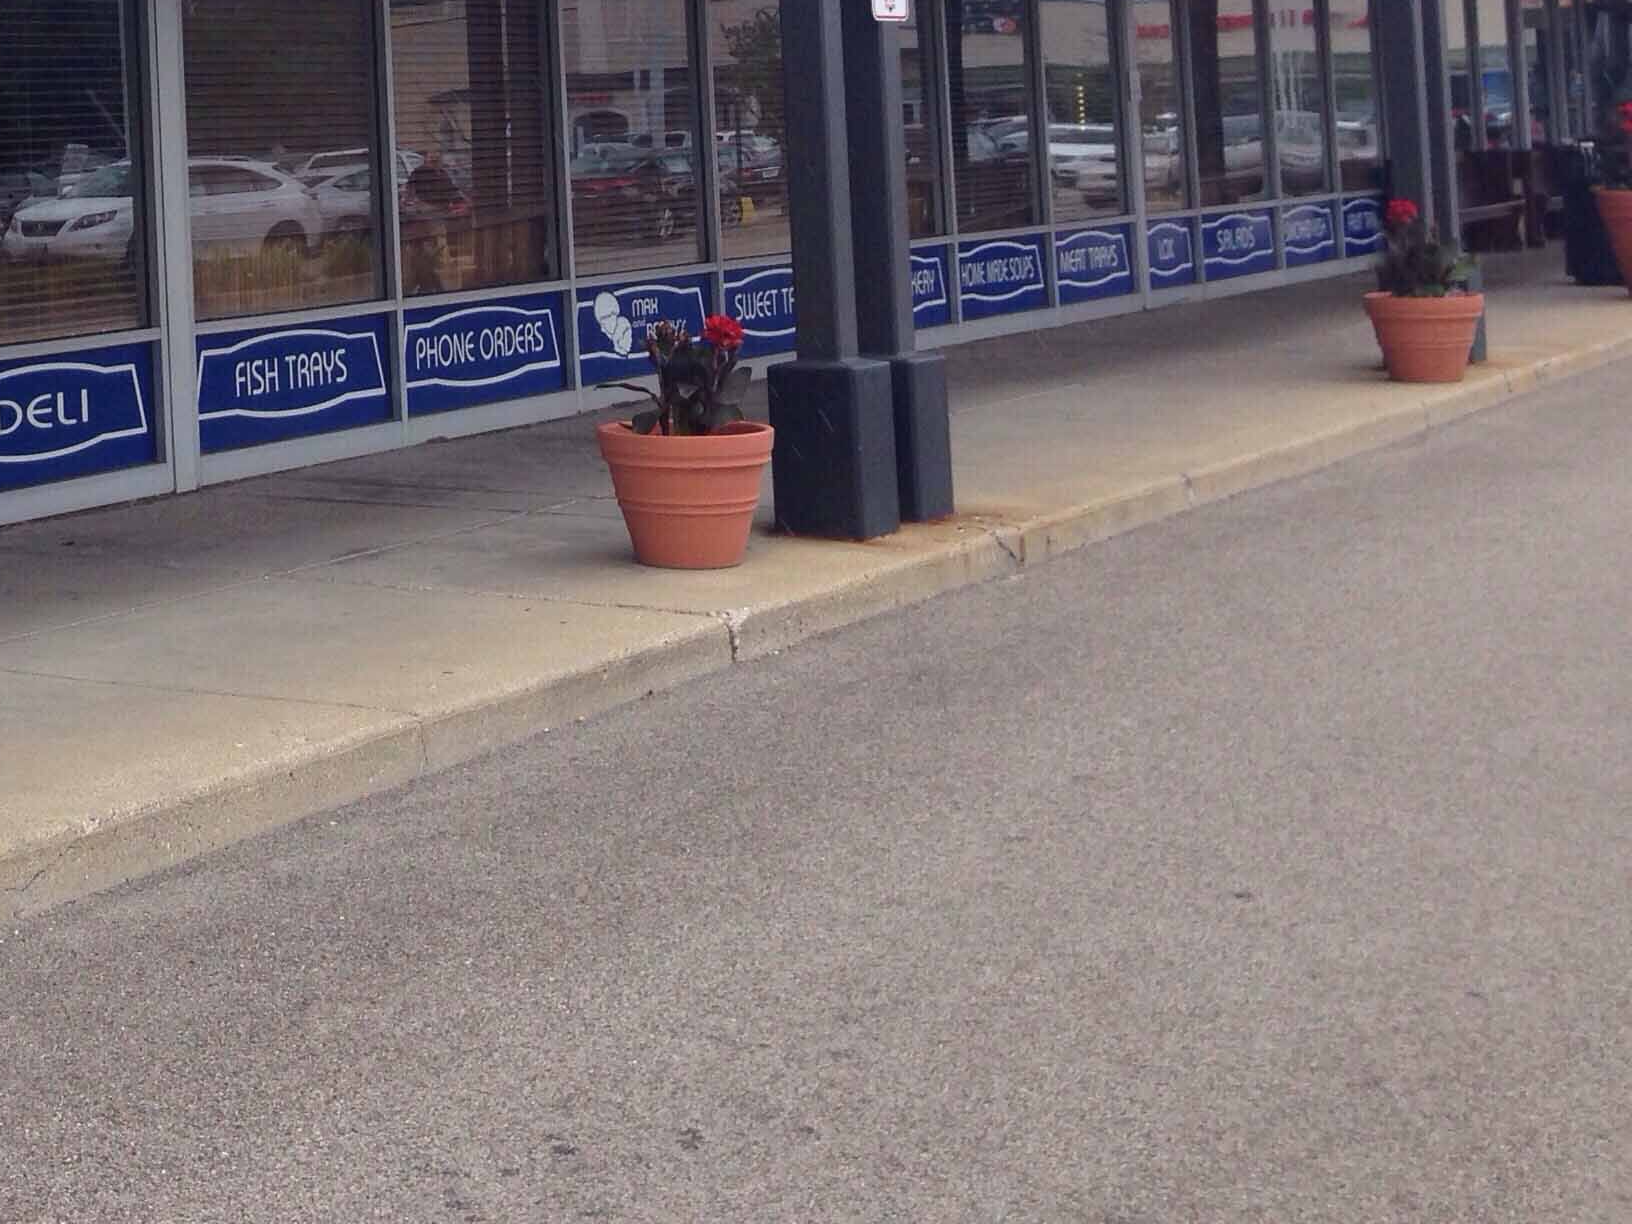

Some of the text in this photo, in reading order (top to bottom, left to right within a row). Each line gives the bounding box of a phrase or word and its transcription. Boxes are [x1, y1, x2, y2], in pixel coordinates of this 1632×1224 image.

[961, 254, 1035, 287] HOME MADE SOUPS
[631, 296, 659, 318] MAX
[734, 290, 778, 321] SWEET
[416, 321, 544, 371] PHONE ORDERS
[235, 348, 348, 398] FISH TRAYS
